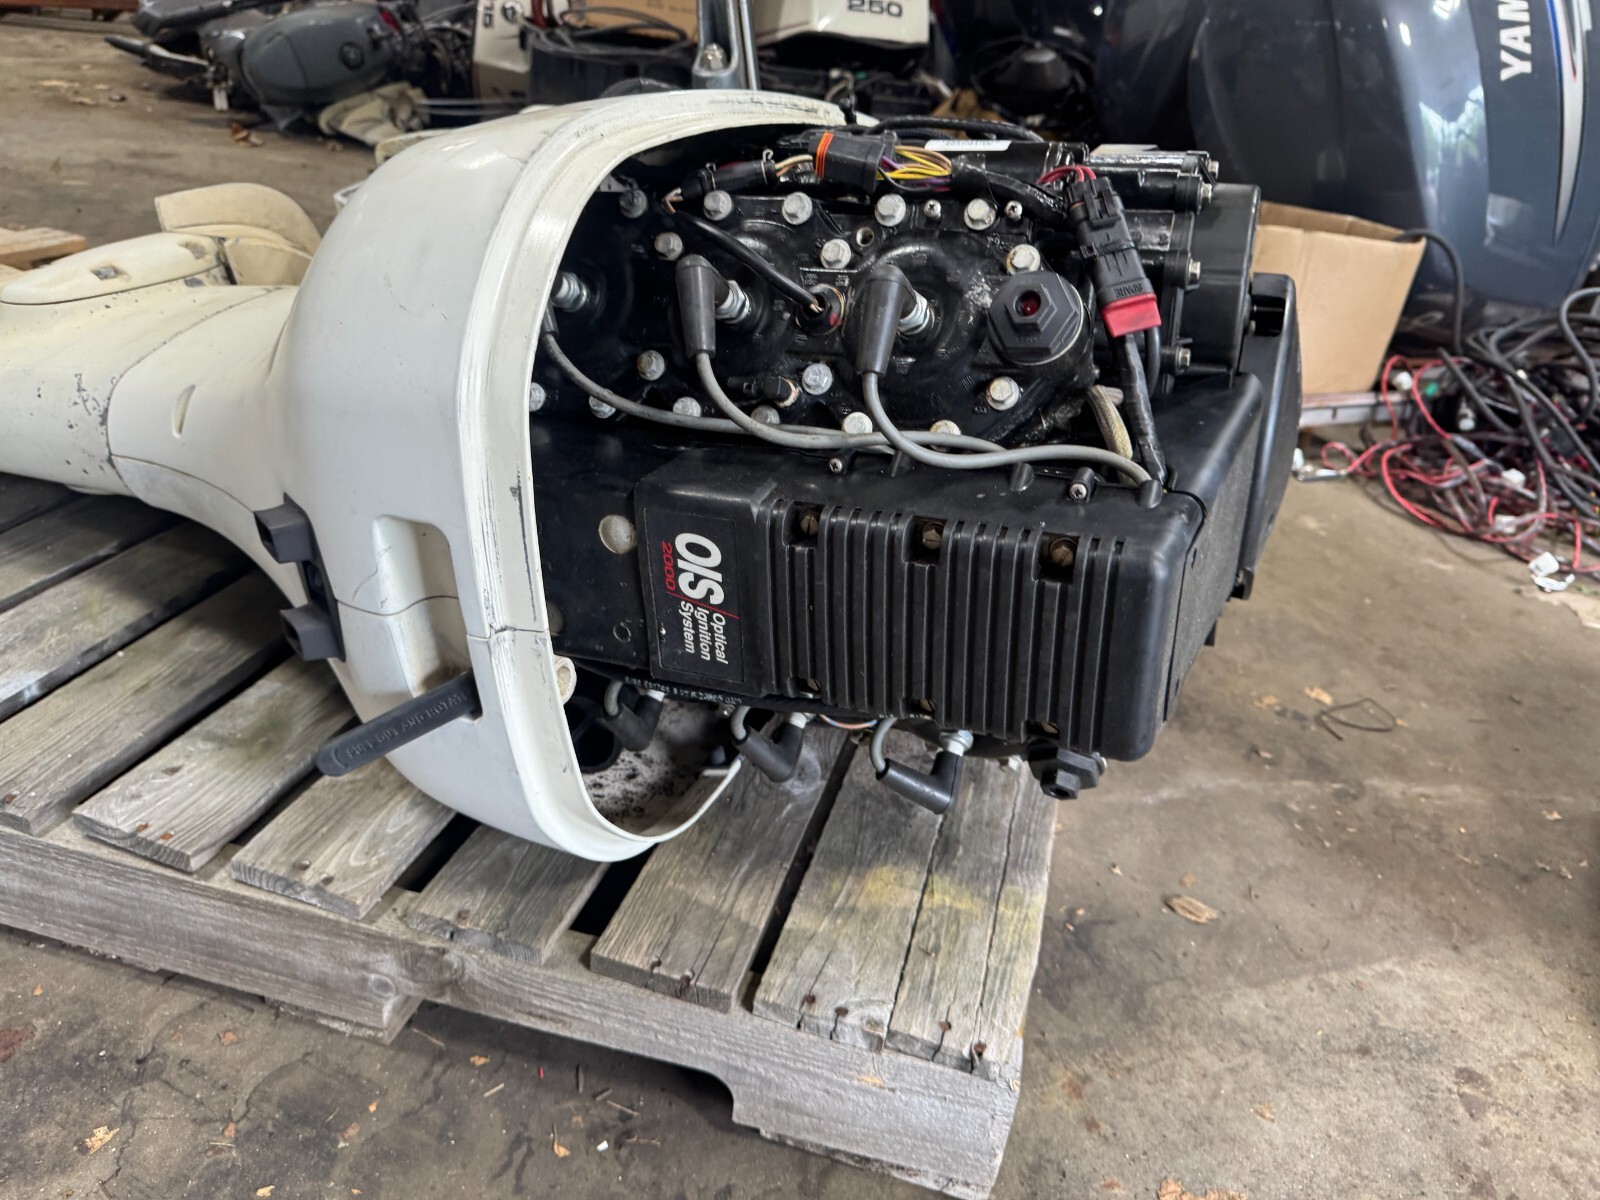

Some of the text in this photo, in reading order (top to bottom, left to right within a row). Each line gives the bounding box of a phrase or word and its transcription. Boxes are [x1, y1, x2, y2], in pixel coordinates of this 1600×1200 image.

[848, 0, 902, 17] 250
[661, 540, 676, 591] 2000
[675, 533, 725, 605] OIS
[679, 600, 696, 654] System
[694, 606, 711, 661] Ignition
[712, 612, 728, 664] Optical
